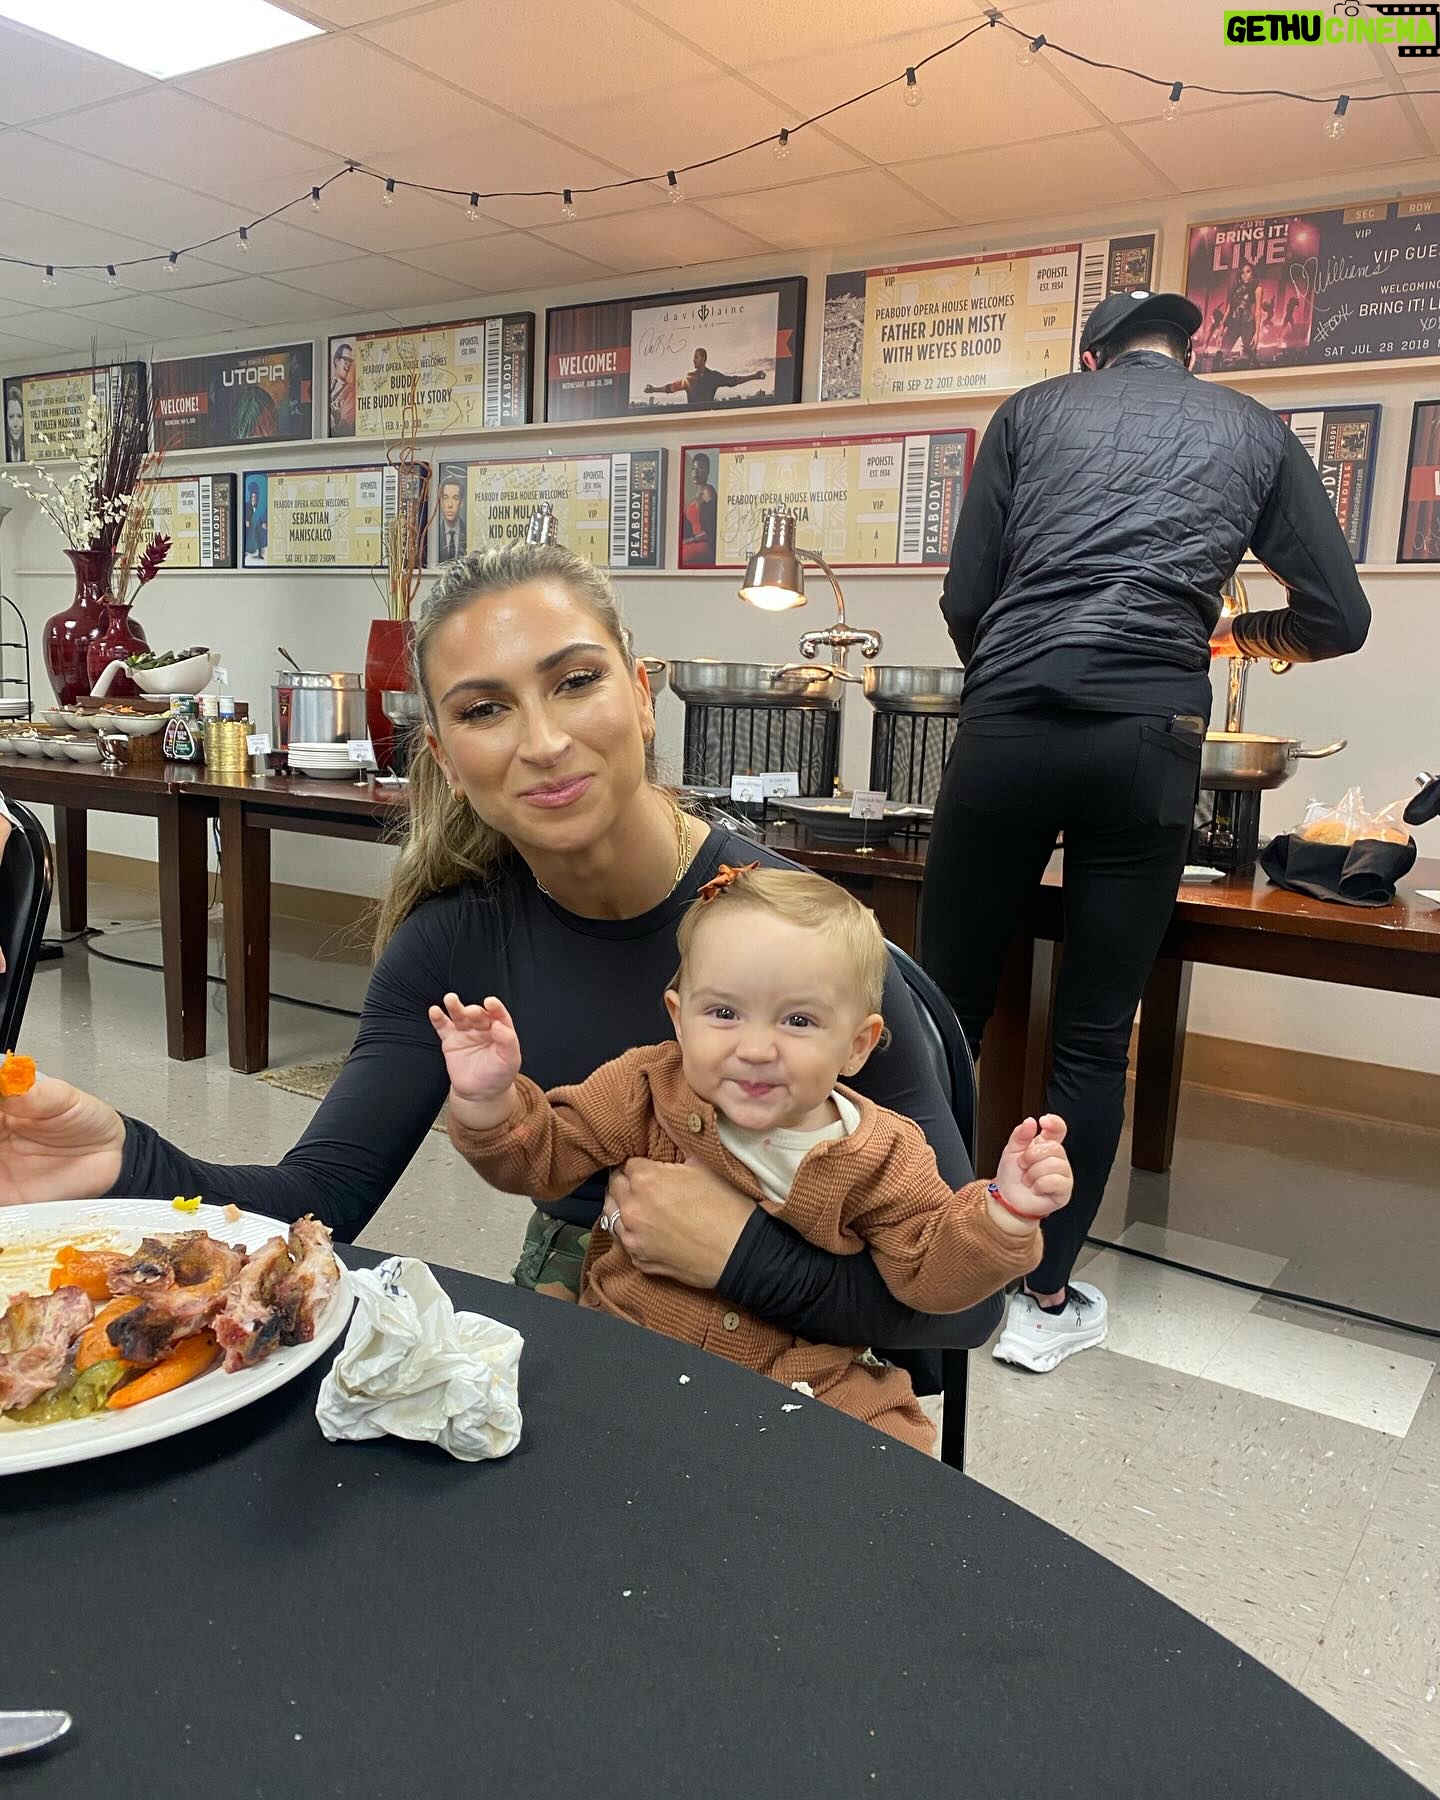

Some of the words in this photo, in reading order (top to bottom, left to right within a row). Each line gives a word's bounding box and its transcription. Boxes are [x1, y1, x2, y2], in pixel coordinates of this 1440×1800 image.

[1355, 208, 1376, 220] SEC
[1409, 201, 1433, 214] ROW
[1215, 227, 1265, 246] BRING
[1268, 223, 1290, 239] IT!
[1355, 228, 1372, 239] VIP
[1414, 223, 1422, 232] A
[1212, 237, 1289, 273] LIVE
[1374, 247, 1400, 264] VIP
[1405, 243, 1440, 261] GUE
[975, 265, 980, 277] A
[1037, 266, 1068, 280] #POHSTL
[884, 276, 896, 288] VIP
[1051, 281, 1064, 291] 1934
[875, 305, 911, 321] PEABODY
[913, 302, 939, 316] OPERA
[941, 299, 968, 314] HOUSE
[971, 294, 1015, 310] WELCOMES
[1359, 299, 1404, 317] BRING
[1408, 297, 1425, 312] IT!
[881, 321, 926, 342] FATHER
[930, 317, 964, 338] JOHN
[968, 313, 1007, 334] MISTY
[1043, 315, 1056, 327] VIP
[883, 345, 913, 364] WITH
[917, 341, 957, 361] WEYES
[961, 337, 1001, 357] BLOOD
[1044, 348, 1050, 360] A
[1324, 346, 1345, 357] SAT
[1351, 343, 1372, 355] JUL
[1379, 341, 1394, 353] 28
[1400, 338, 1430, 351] 2018
[363, 364, 385, 375] PEABODY
[386, 361, 402, 372] OPERA
[421, 356, 447, 368] WELCOMES
[559, 351, 617, 376] WELCOME!
[222, 364, 285, 387] UTOPIA
[390, 374, 418, 389] BUDD
[464, 373, 473, 383] VIP
[503, 355, 512, 417] PEABODY
[892, 380, 904, 392] FRI
[907, 379, 921, 391] SEP
[924, 378, 934, 389] 22
[937, 376, 954, 389] 2017
[957, 374, 987, 387] 8:00PM
[160, 396, 199, 415] WELCOME!
[358, 396, 371, 411] THE
[373, 393, 399, 409] BUDDY
[402, 391, 426, 407] HOLY
[427, 388, 453, 404] STORY
[34, 420, 57, 431] KATHLEEN
[58, 417, 80, 429] MADIGAN
[734, 454, 745, 464] VIP
[814, 449, 818, 459] A
[867, 455, 894, 467] #POHSTL
[480, 467, 488, 476] VIP
[541, 464, 546, 473] A
[1341, 465, 1352, 504] HOUSE
[474, 491, 499, 502] PEABODY
[500, 490, 518, 501] OPERA
[519, 490, 538, 500] HOUSE
[539, 489, 569, 499] WELCOMES
[727, 494, 758, 506] PEABODY
[758, 492, 782, 504] OPERA
[784, 491, 808, 503] HOUSE
[809, 490, 848, 502] WELCOMES
[274, 500, 293, 509] PEABODY
[294, 499, 309, 508] OPERA
[310, 498, 324, 507] HOUSE
[325, 498, 350, 507] WELCOMES
[873, 500, 884, 510] VIP
[292, 511, 329, 525] SEBASTIAN
[488, 505, 511, 520] JOHN
[588, 509, 598, 519] VIP
[926, 479, 941, 553] PEABODY
[488, 524, 503, 539] KID
[630, 492, 641, 557] PEABODY
[289, 528, 332, 542] MANISCALCO
[874, 529, 879, 540] A
[942, 520, 950, 552] OPERA
[285, 554, 293, 563] SAT
[294, 554, 303, 562] DEC
[281, 706, 288, 715] 7
